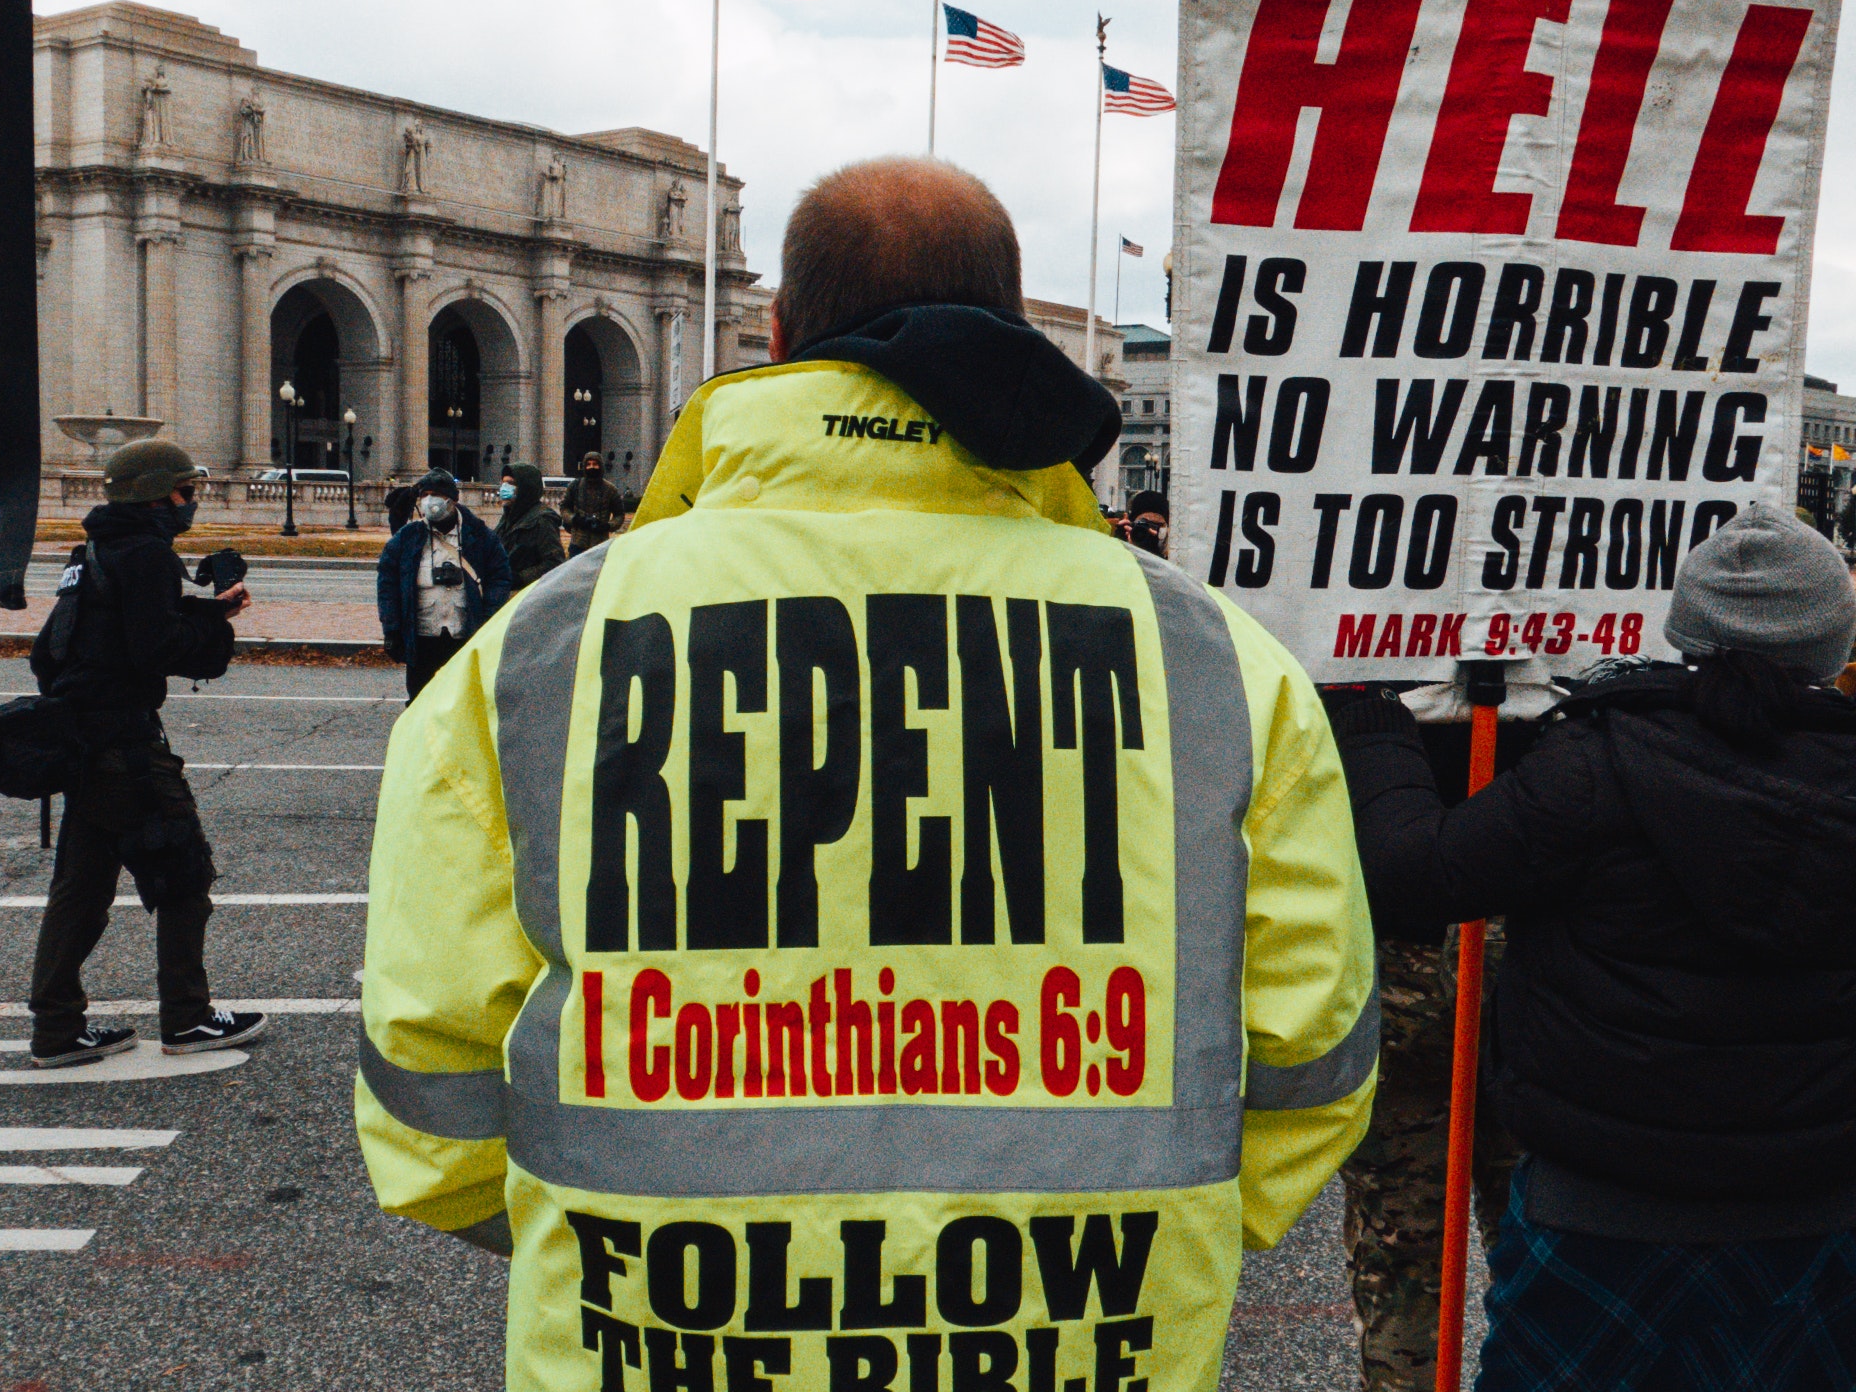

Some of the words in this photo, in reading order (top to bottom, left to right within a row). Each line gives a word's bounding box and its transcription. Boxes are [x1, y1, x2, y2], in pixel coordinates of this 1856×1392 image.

[1207, 255, 1307, 356] IS
[1339, 261, 1782, 374] HORRIBLE
[822, 414, 943, 445] TINGLEY
[1210, 374, 1331, 474] NO
[1370, 378, 1769, 483] WARNING
[1207, 490, 1282, 588] IS
[1309, 493, 1459, 591] TOO
[1332, 613, 1465, 659] MARK
[1483, 612, 1645, 658] 9:43-48
[584, 592, 1145, 953] REPENT
[628, 967, 1019, 1103] Corinthians
[1038, 965, 1146, 1098] 6:9
[566, 1210, 1159, 1331] FOLLOW
